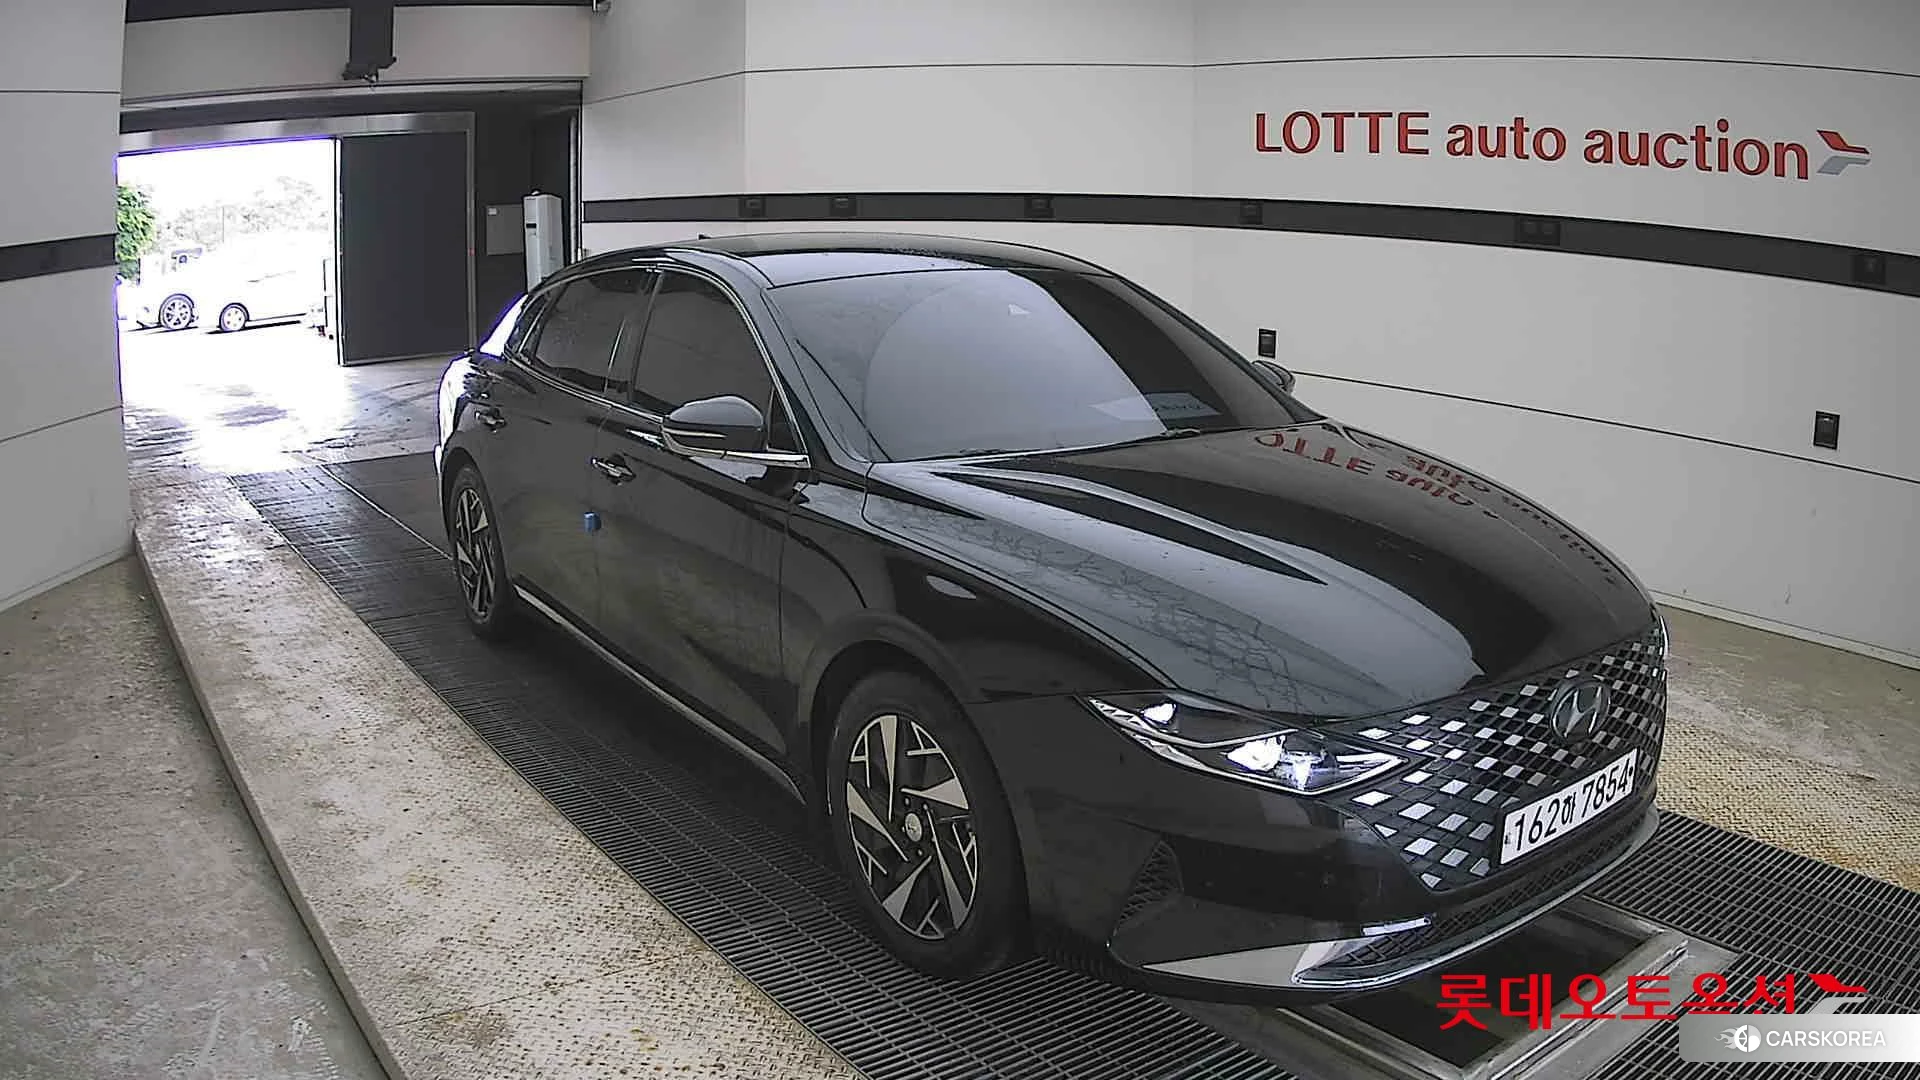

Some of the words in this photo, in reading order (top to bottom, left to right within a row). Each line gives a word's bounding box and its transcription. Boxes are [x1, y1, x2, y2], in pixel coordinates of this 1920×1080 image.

[1255, 111, 1430, 155] LOTTE
[1446, 116, 1567, 160] auto
[1583, 119, 1808, 180] auction
[1581, 758, 1631, 818] 7854
